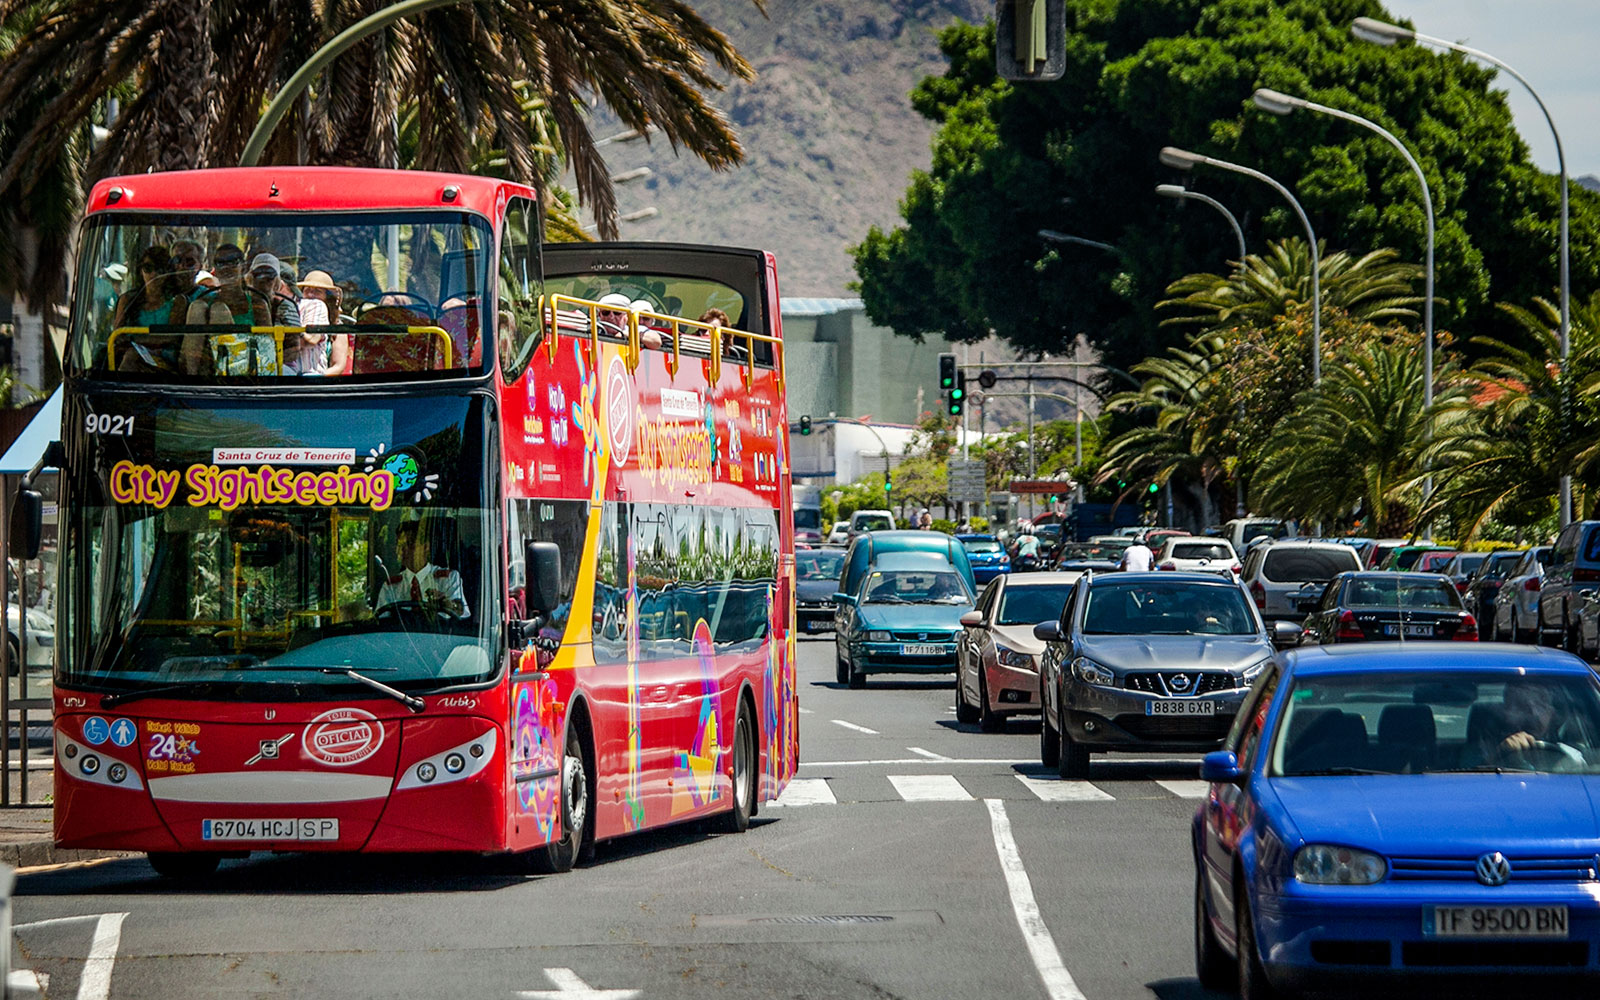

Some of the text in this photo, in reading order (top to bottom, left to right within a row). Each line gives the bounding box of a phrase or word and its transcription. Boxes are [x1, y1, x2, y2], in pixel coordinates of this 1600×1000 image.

[85, 413, 135, 436] 9021
[217, 451, 352, 461] Santa Cruz de Tenerife
[110, 460, 394, 513] City Sightseeing
[327, 711, 353, 721] TOUR
[1154, 702, 1212, 714] 8838 GXR
[149, 733, 177, 759] 24
[318, 728, 369, 746] OFICIAL
[214, 821, 294, 837] 6704 HCJ
[1436, 908, 1566, 931] TF 9500 BN
